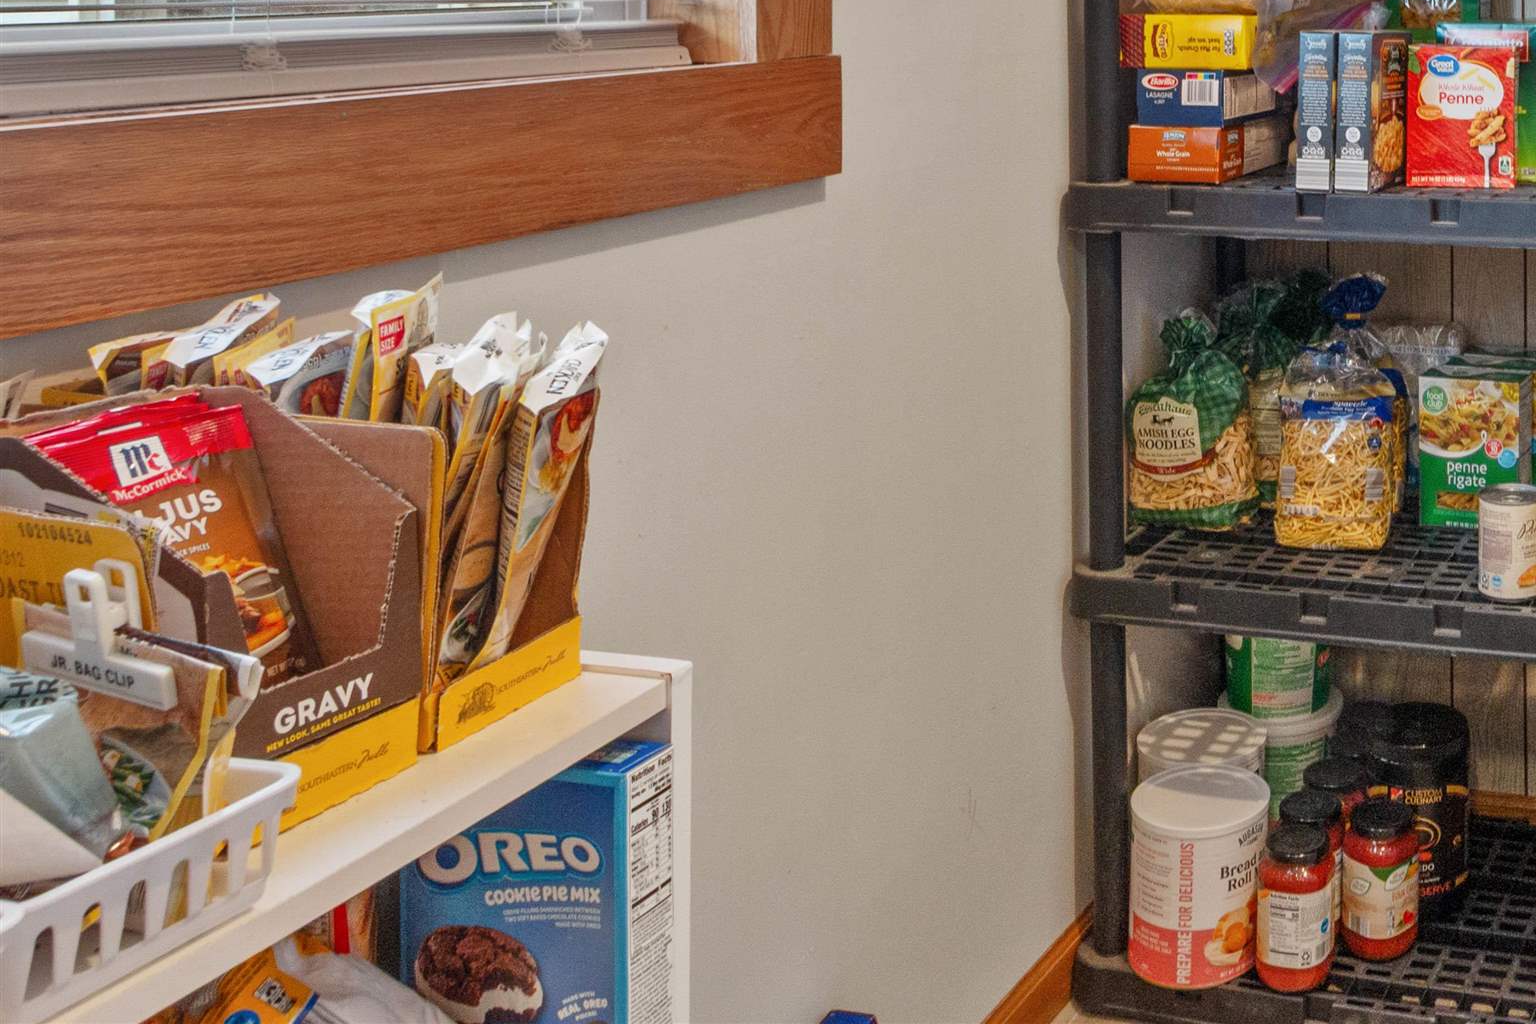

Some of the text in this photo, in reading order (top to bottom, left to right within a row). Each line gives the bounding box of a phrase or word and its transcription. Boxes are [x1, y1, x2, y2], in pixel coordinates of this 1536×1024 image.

[1438, 92, 1485, 106] Penne
[379, 317, 404, 338] FAMILY
[379, 337, 397, 353] SIZE
[1425, 390, 1445, 403] food
[1137, 427, 1195, 438] AMISH EGG
[1138, 438, 1196, 451] NOODLES
[1446, 461, 1488, 478] penne
[111, 466, 188, 502] McCormick
[1447, 473, 1487, 489] rigate
[157, 489, 223, 525] JUS
[17, 523, 94, 546] 102104524
[74, 661, 102, 681] BAG
[103, 668, 136, 690] CLIP
[273, 673, 375, 735] GRAVY
[266, 739, 285, 754] NEW
[310, 718, 332, 737] SAME
[331, 709, 357, 728] GREAT
[355, 698, 382, 717] TASTE!
[631, 753, 672, 784] Nutrition Facts
[1404, 789, 1443, 799] CUSTOM
[1404, 795, 1443, 805] CULINARY
[418, 831, 601, 885] OREO
[1220, 858, 1257, 880] Bread
[1227, 876, 1253, 892] Roll
[570, 886, 601, 903] MIX
[1176, 841, 1195, 985] PREPARE FOR DELICIOUS
[582, 998, 608, 1010] OREO
